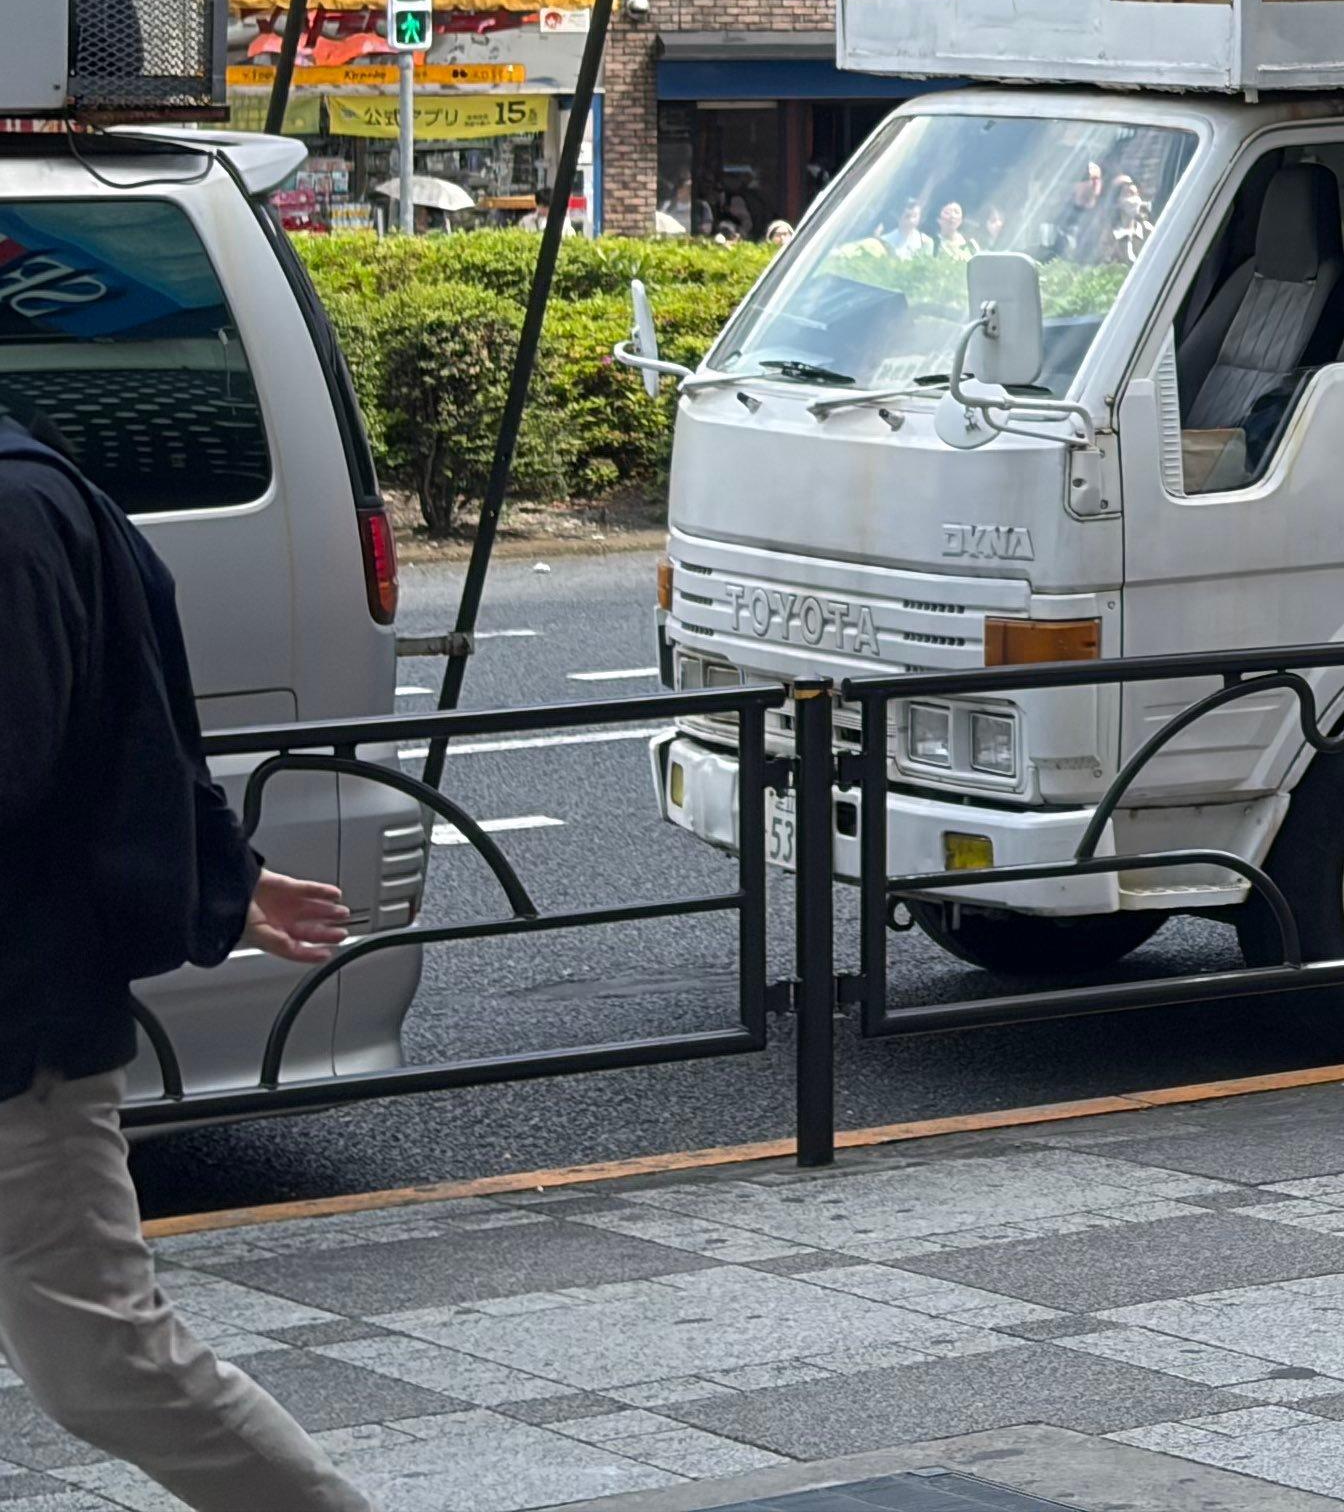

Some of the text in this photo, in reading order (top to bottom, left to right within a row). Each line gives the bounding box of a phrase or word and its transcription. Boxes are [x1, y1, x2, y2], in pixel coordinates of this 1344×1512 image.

[364, 105, 459, 127] 公式プリ
[725, 583, 880, 656] TOYOTA
